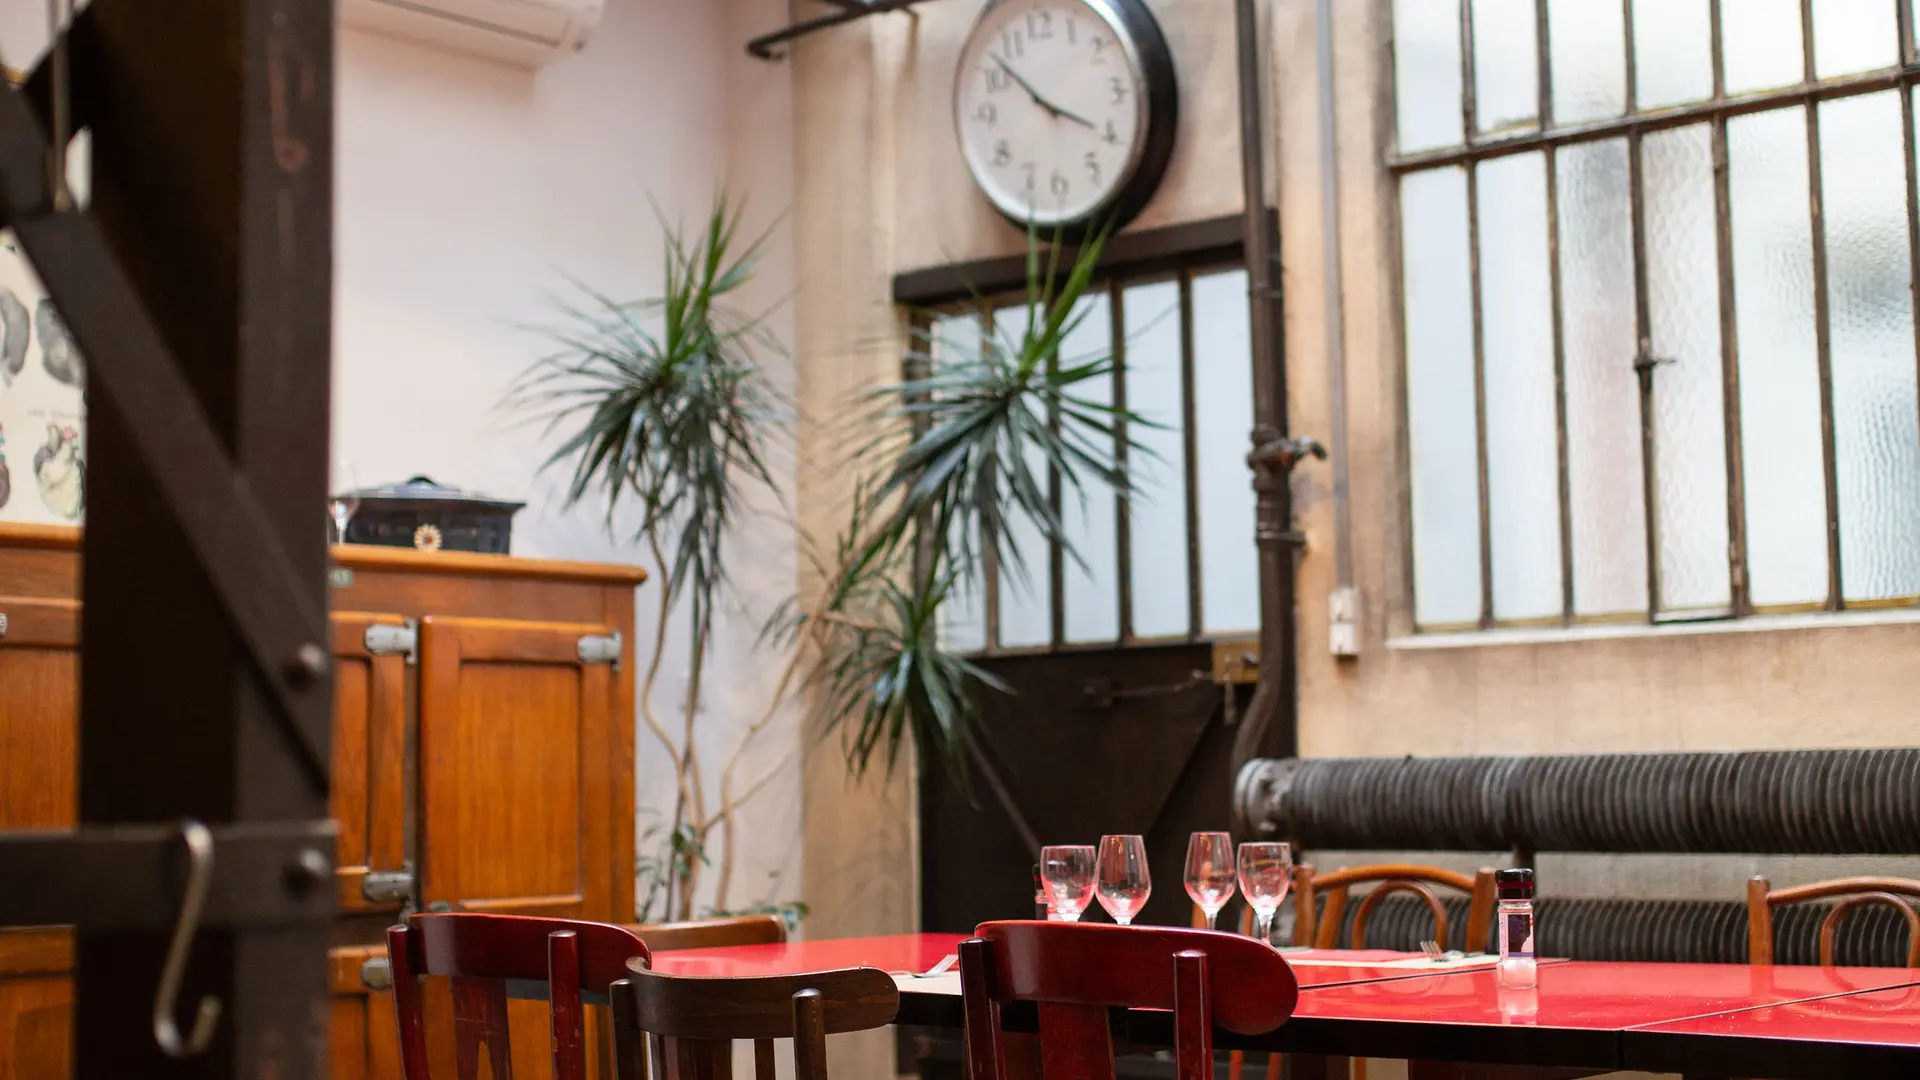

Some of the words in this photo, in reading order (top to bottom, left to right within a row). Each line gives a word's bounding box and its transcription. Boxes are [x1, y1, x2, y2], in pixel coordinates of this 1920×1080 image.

[1027, 11, 1054, 40] 12
[1066, 17, 1077, 44] 1
[1002, 30, 1024, 58] 11
[1089, 36, 1107, 65] 2
[984, 66, 1012, 94] 10
[1109, 76, 1127, 105] 3
[973, 102, 997, 128] 9
[1101, 119, 1125, 144] 4
[993, 139, 1011, 168] 8
[1084, 149, 1102, 186] 5
[1021, 159, 1036, 192] 7
[1050, 167, 1069, 196] 6
